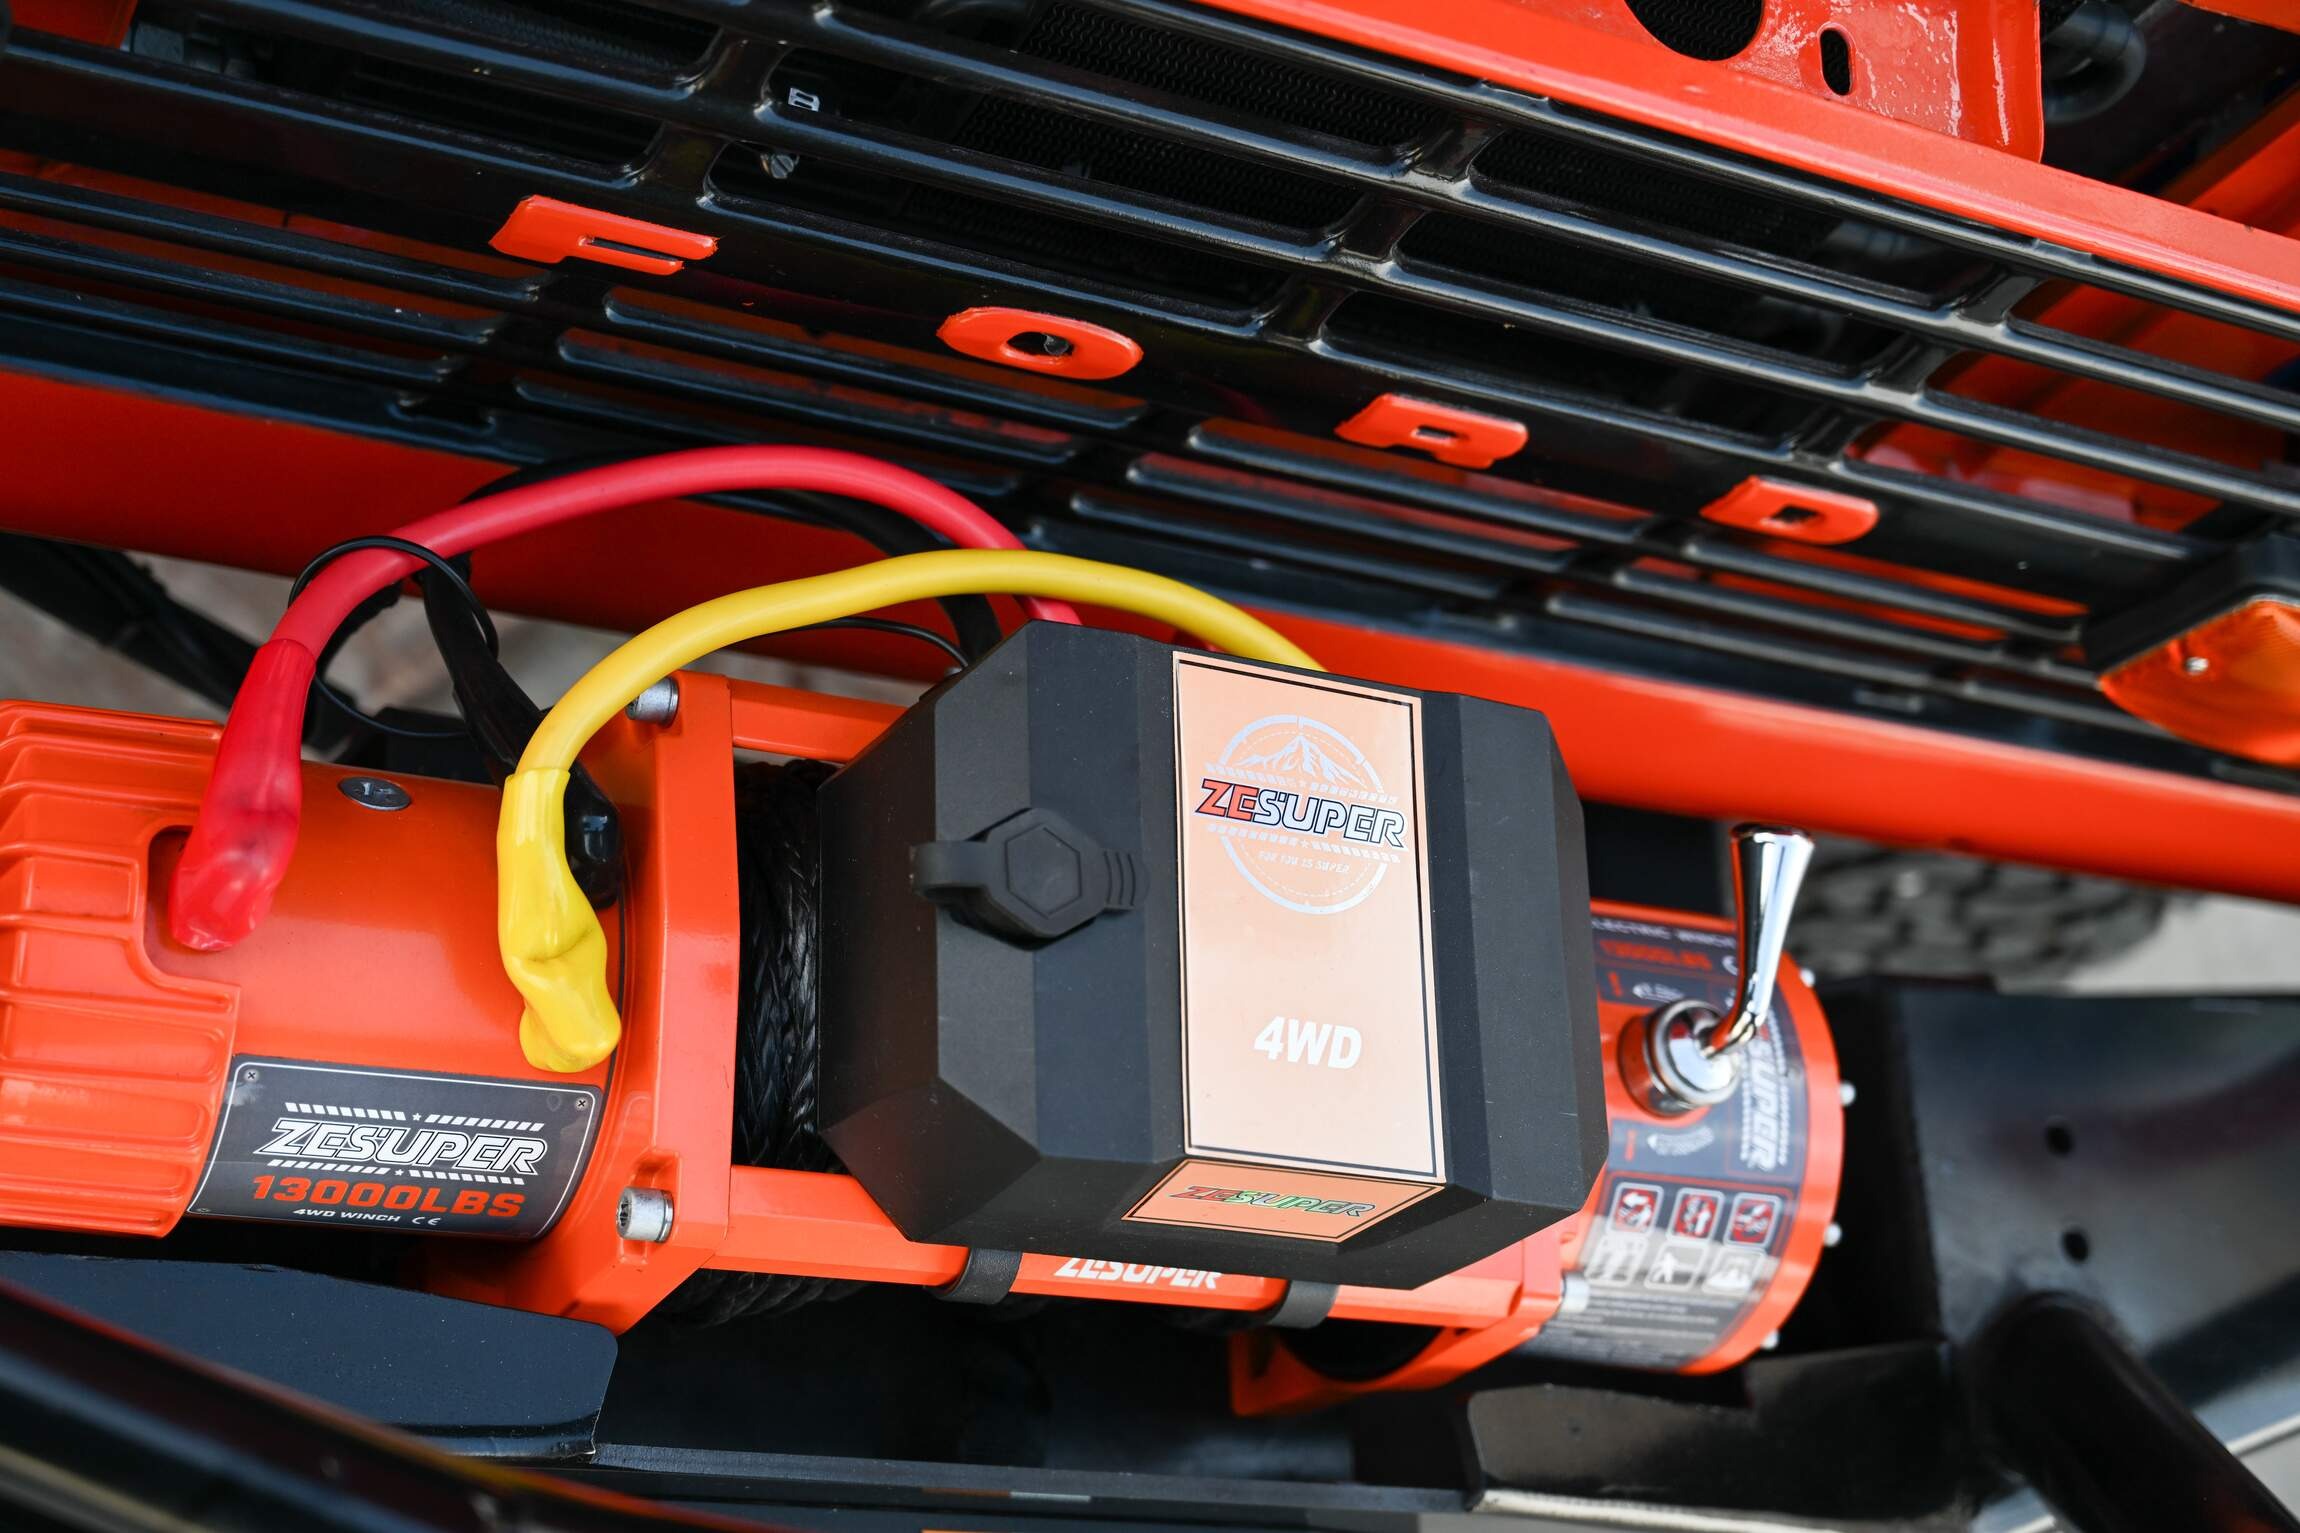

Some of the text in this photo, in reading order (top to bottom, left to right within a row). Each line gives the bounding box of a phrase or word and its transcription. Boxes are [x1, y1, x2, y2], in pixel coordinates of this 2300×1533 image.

[1194, 778, 1406, 848] ZESUPER
[1314, 860, 1352, 873] SUPER
[1254, 1015, 1362, 1069] 4WD
[253, 1117, 549, 1176] ZESUPER
[252, 1174, 526, 1219] 13000LBS
[292, 1208, 336, 1218] 4WD
[340, 1211, 402, 1222] WINCH
[1169, 1185, 1377, 1218] ZESUPER
